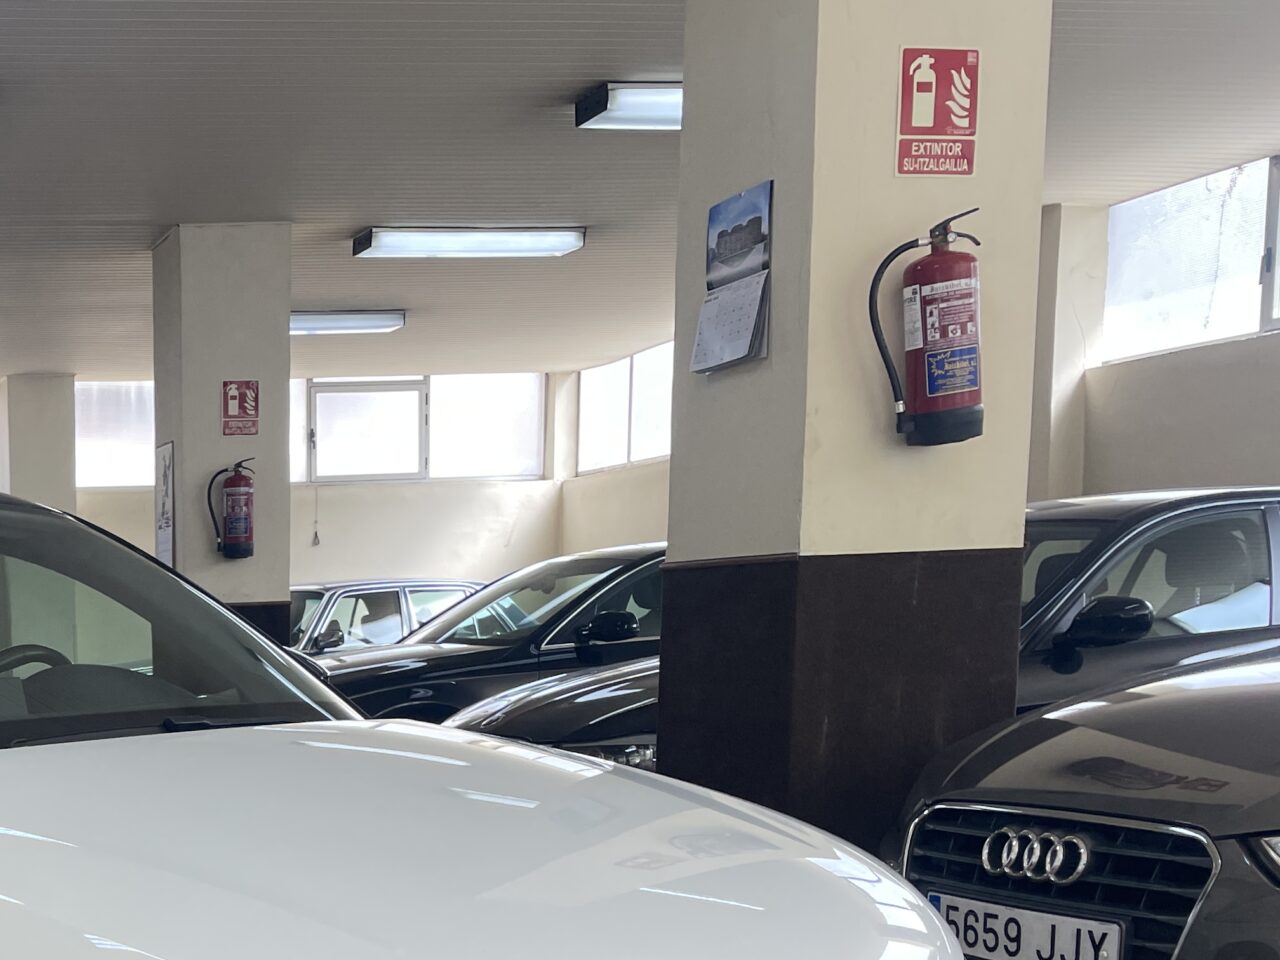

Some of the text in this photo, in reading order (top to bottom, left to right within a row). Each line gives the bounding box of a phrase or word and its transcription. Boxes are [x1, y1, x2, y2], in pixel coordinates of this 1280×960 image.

[912, 142, 962, 156] EXTINTOR
[903, 158, 969, 171] SU-ITZALGAILUA
[945, 905, 1022, 957] 5659
